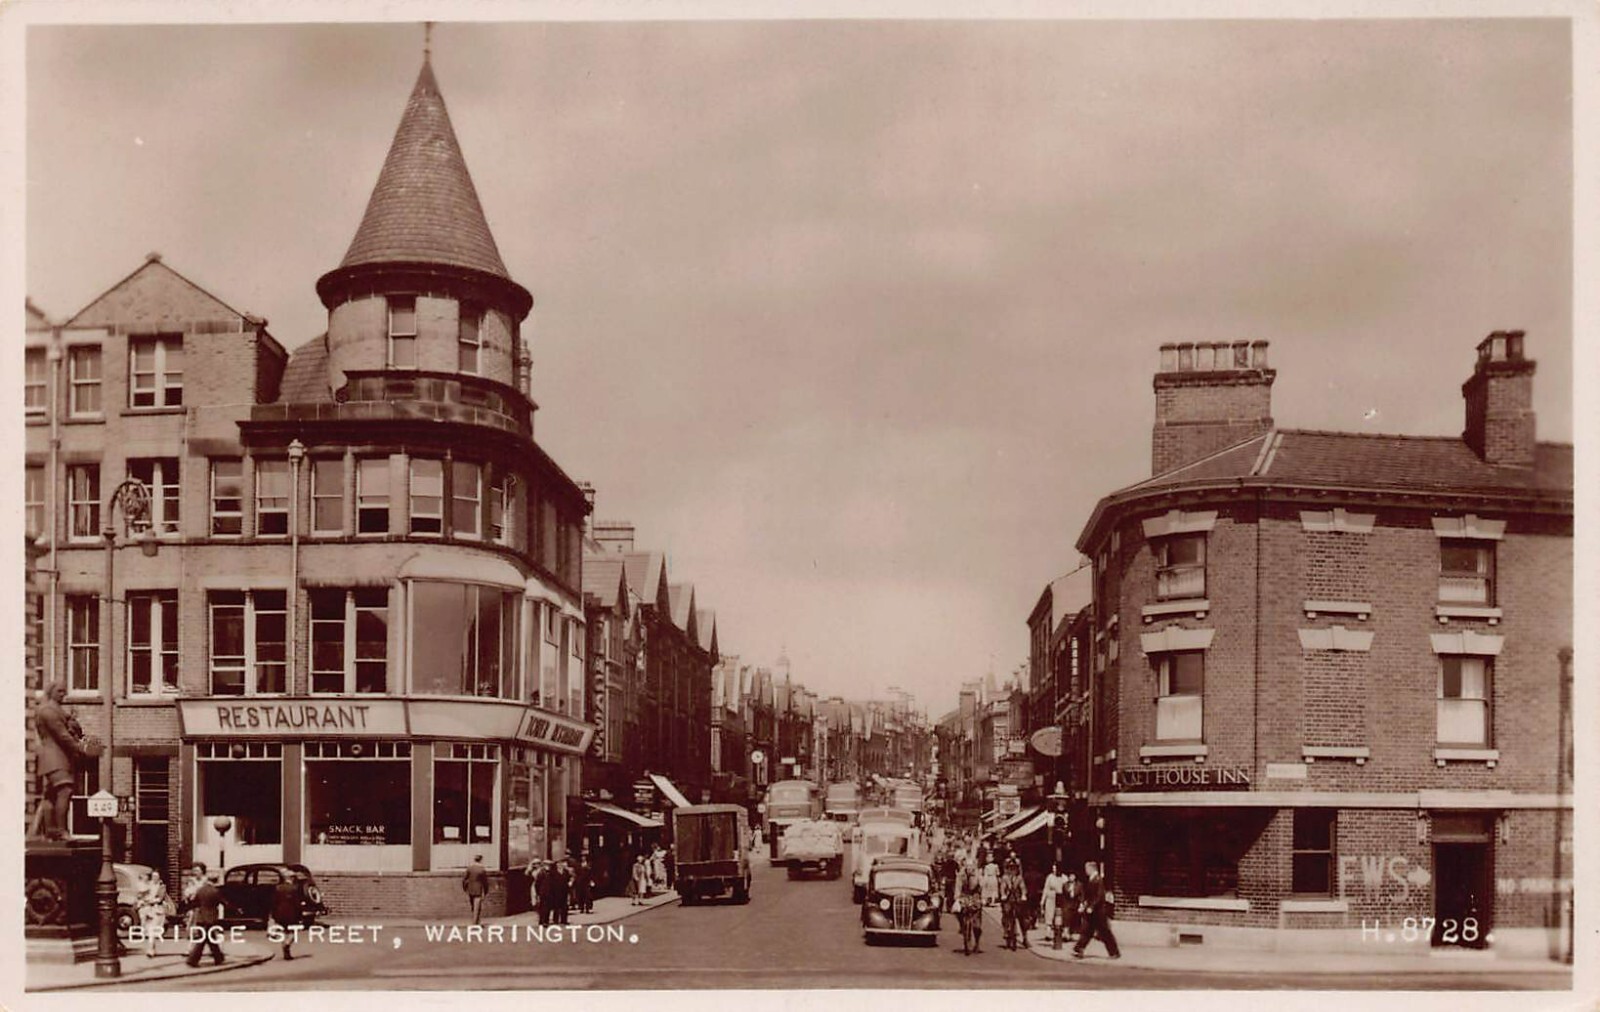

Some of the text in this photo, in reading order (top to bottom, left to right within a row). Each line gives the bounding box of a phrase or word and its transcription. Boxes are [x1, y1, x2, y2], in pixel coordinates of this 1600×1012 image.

[217, 706, 370, 729] RESTAURANT
[1155, 768, 1210, 785] HOUSE
[1217, 768, 1250, 785] INN
[328, 825, 385, 834] SNACK BAR
